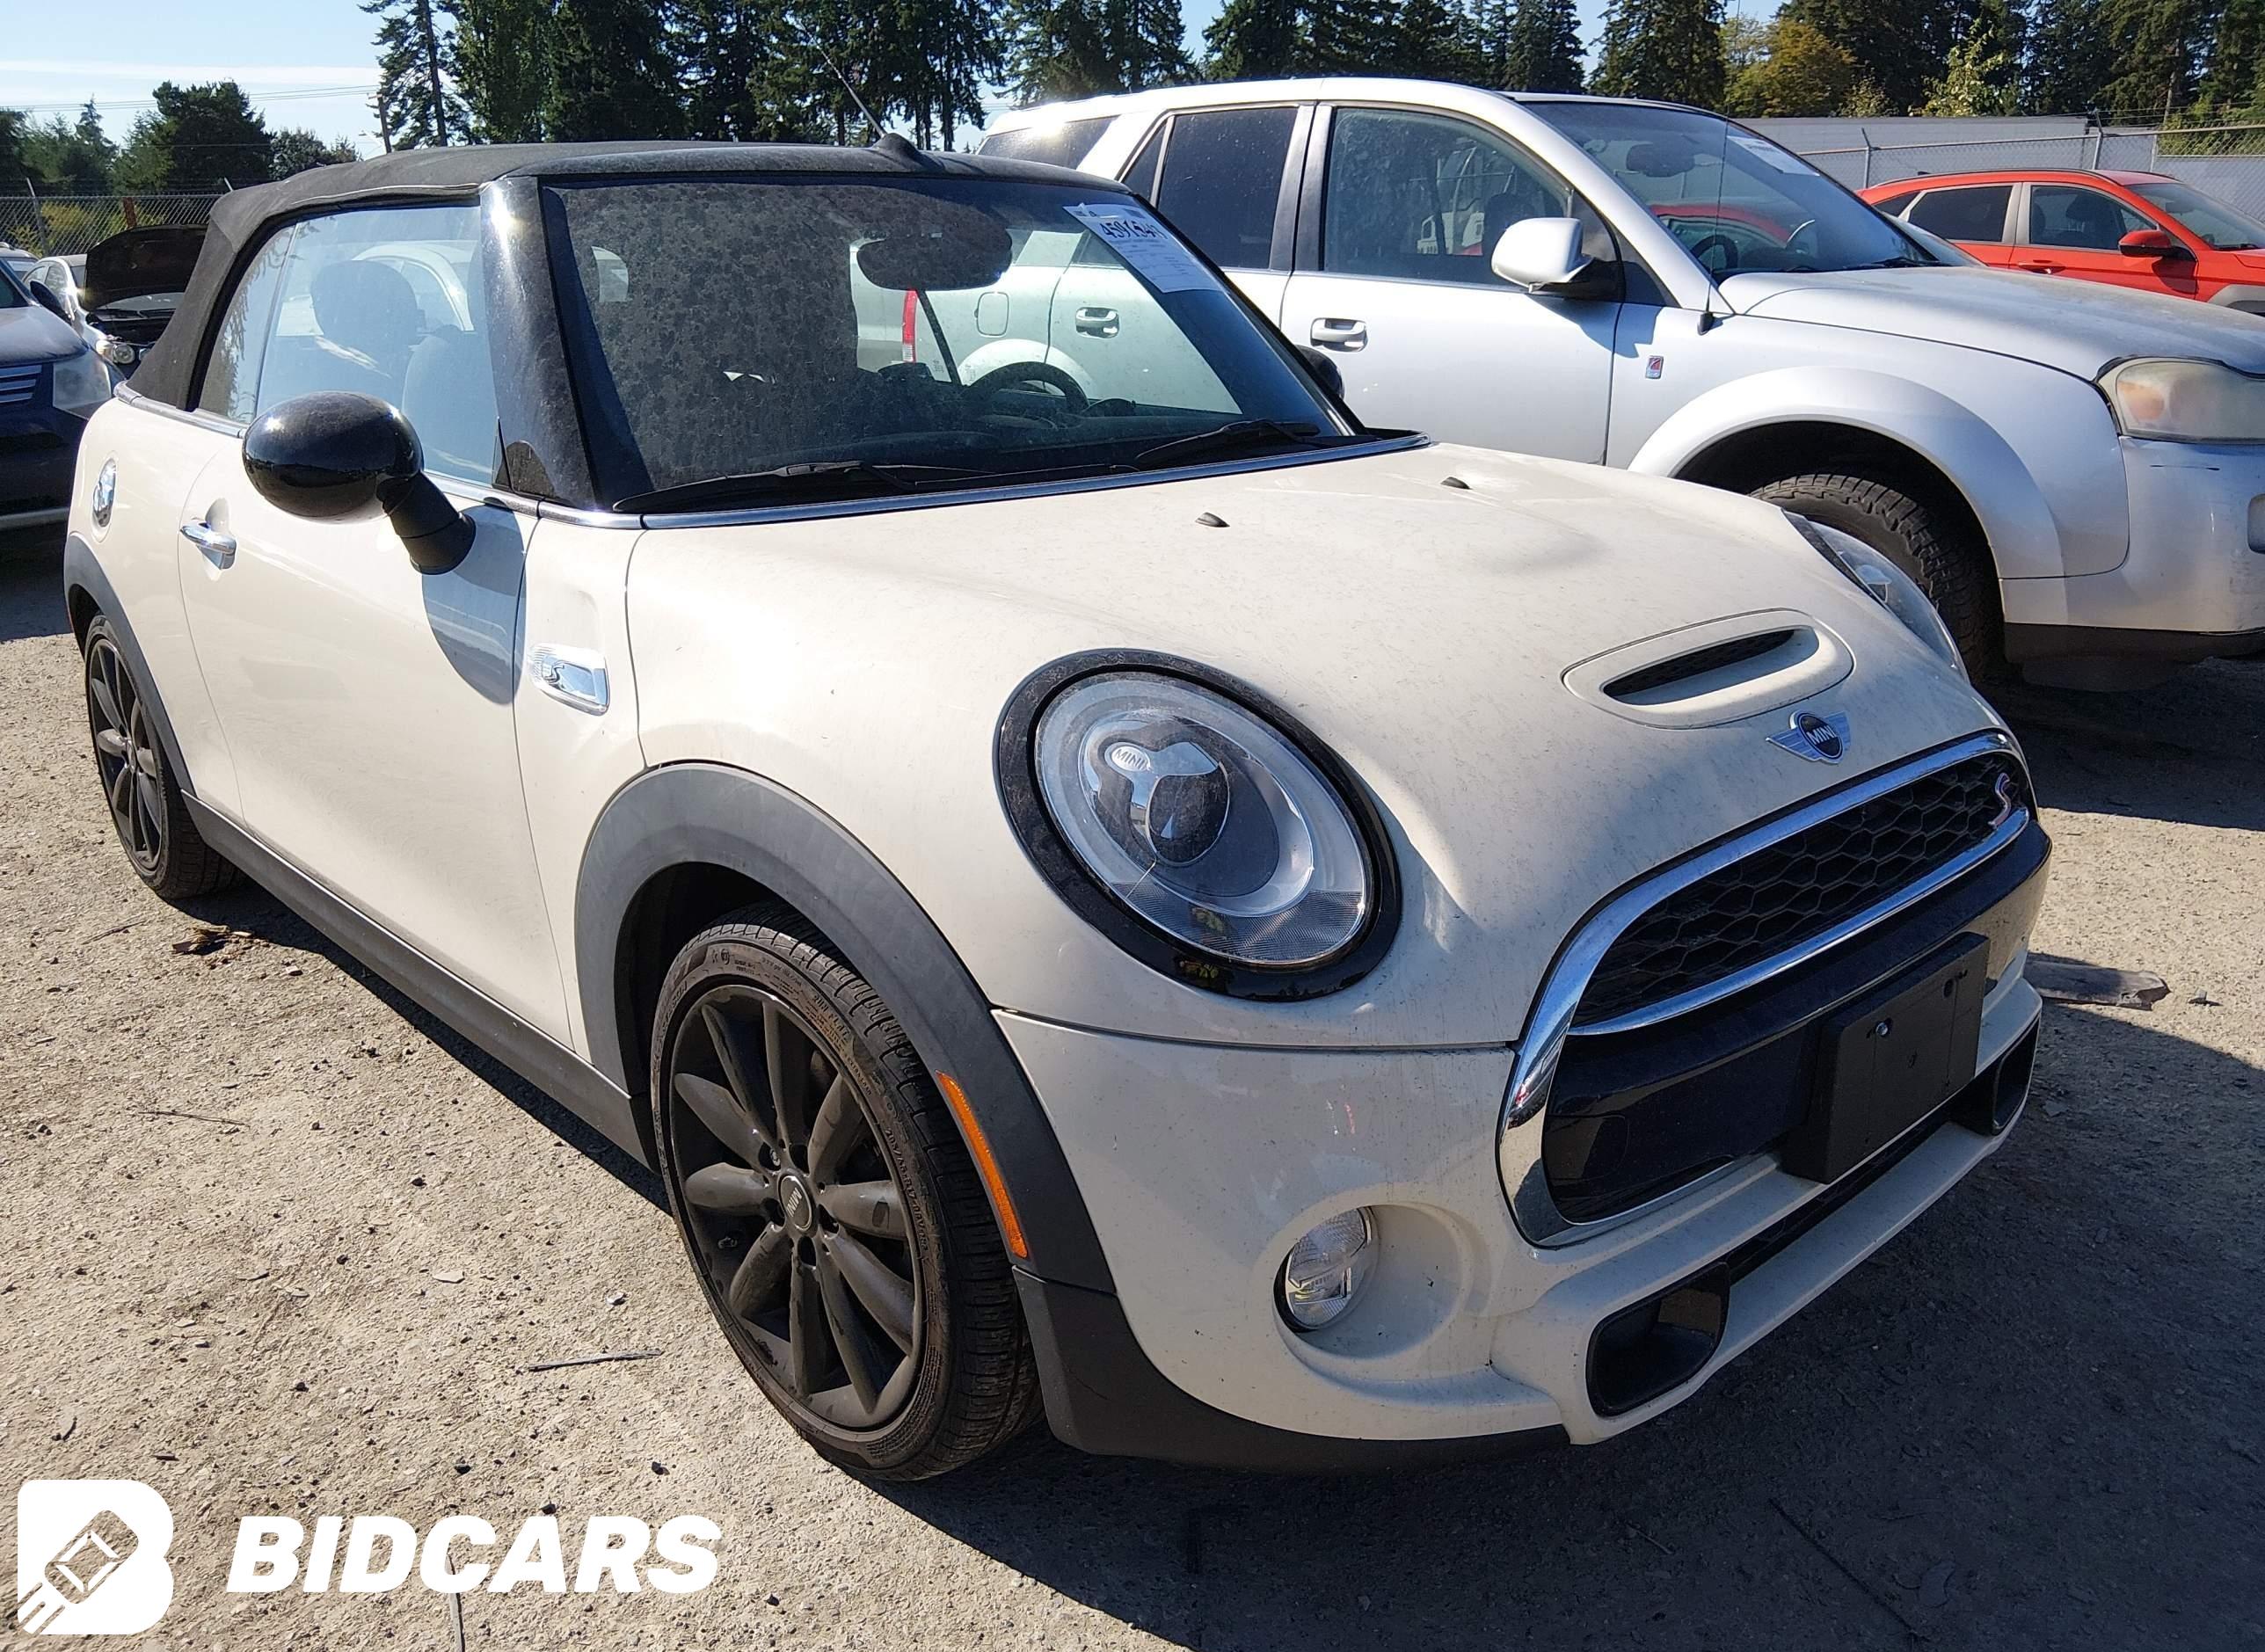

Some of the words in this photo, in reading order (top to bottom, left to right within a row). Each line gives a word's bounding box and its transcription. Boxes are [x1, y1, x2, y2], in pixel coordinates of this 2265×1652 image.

[1806, 725, 1837, 746] MINI
[1115, 748, 1147, 770] MINI
[786, 1187, 803, 1219] MINI
